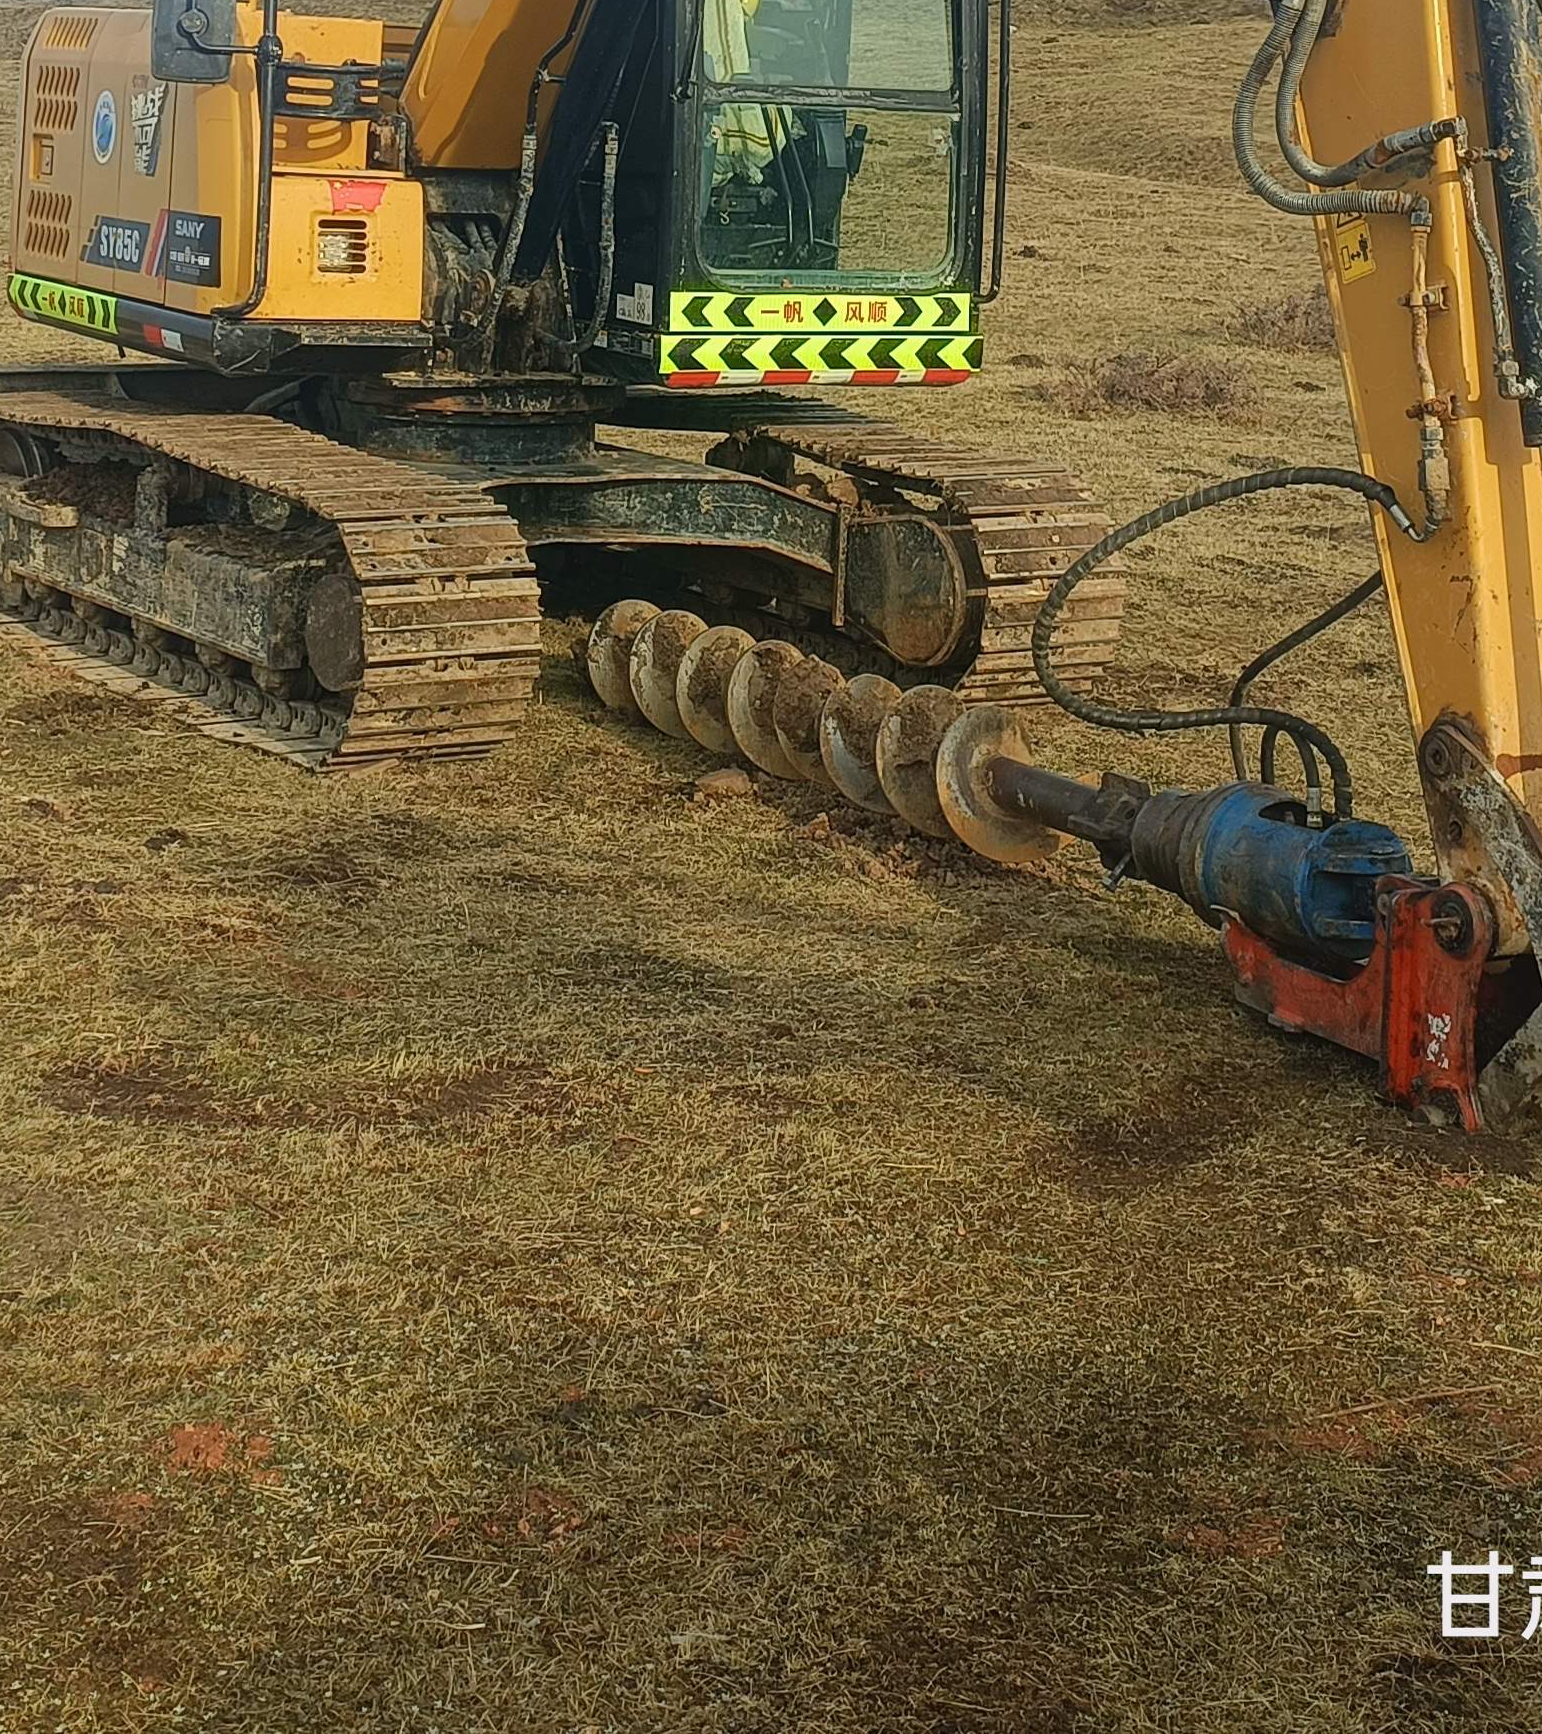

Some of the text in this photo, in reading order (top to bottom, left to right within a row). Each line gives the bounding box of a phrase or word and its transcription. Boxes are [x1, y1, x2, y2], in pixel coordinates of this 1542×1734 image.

[174, 218, 205, 240] SANY
[99, 224, 141, 264] SY85C
[760, 300, 888, 323] 一帆 风顺
